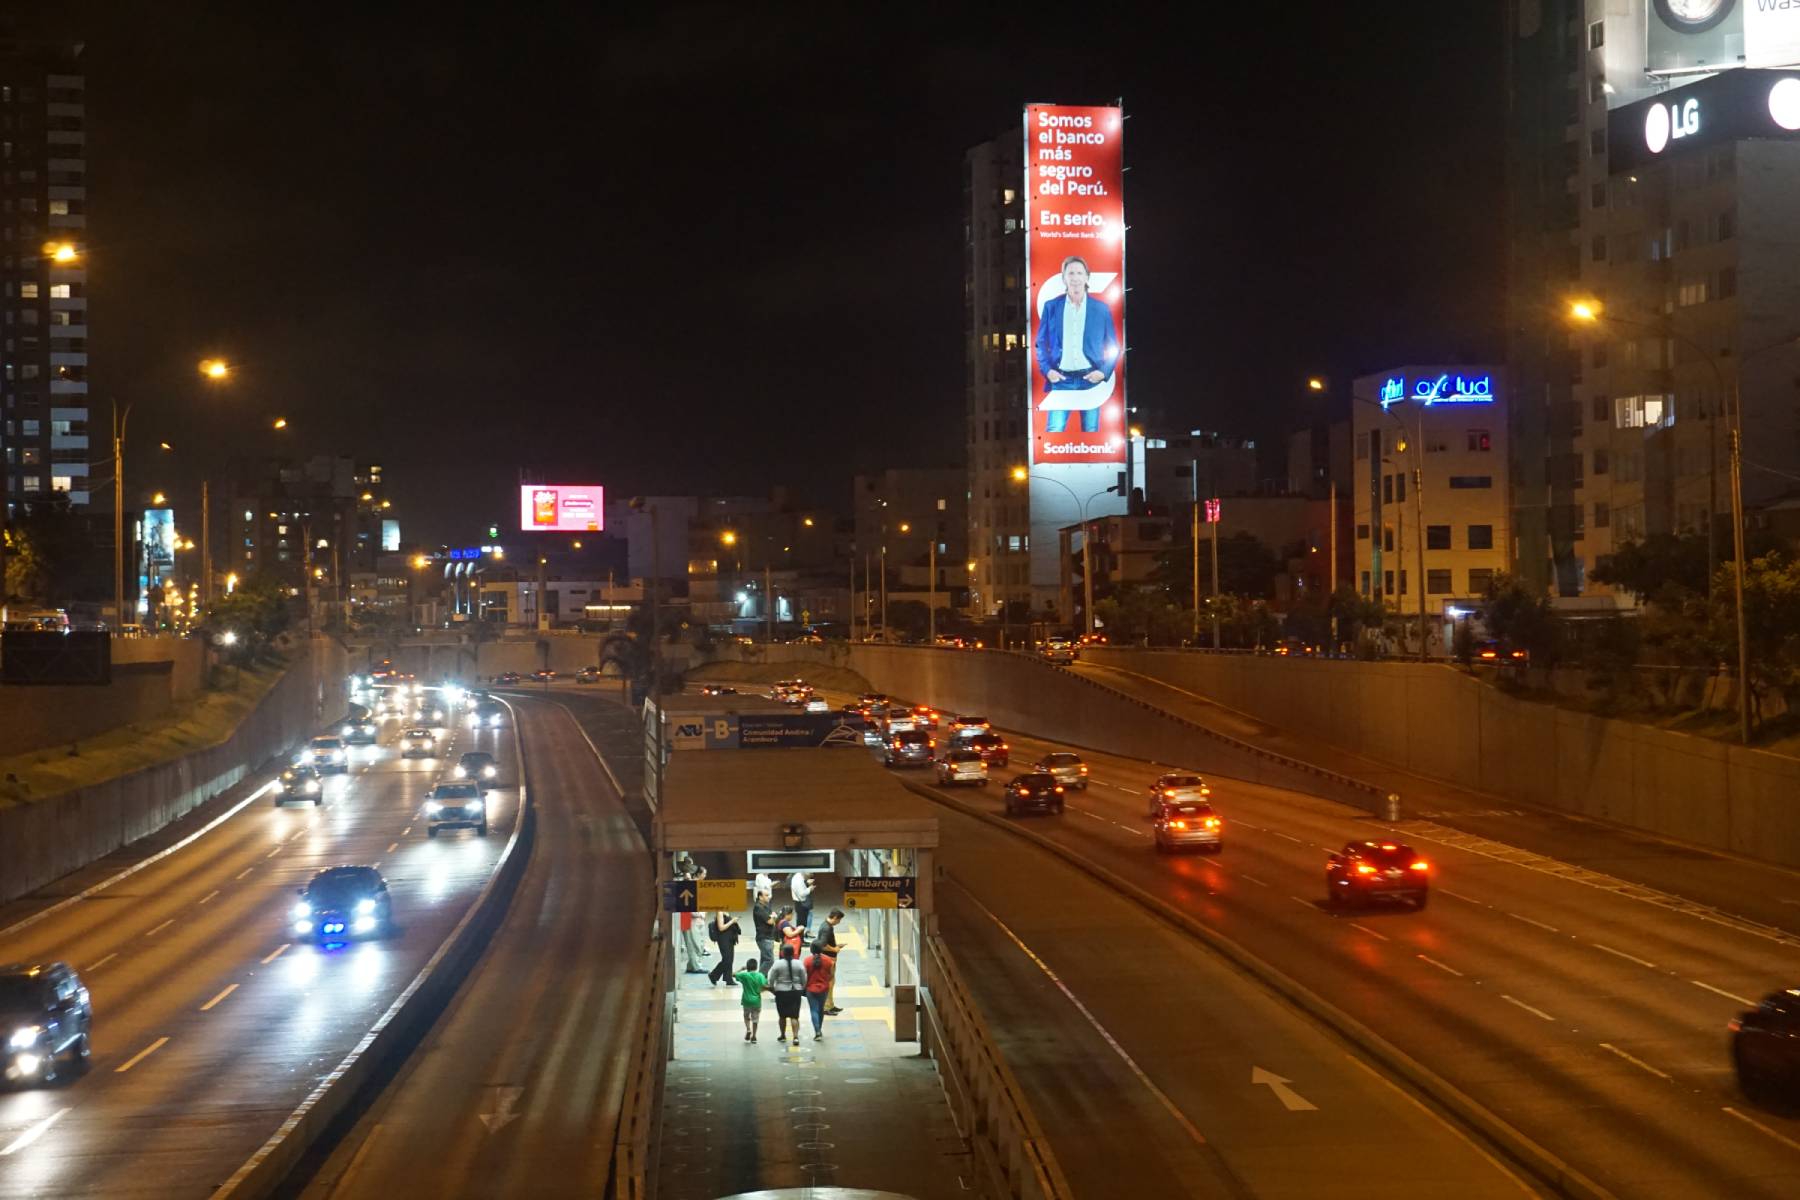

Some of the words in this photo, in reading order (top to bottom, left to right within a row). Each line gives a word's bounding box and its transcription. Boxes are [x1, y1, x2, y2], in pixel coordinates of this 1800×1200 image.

[1039, 112, 1092, 127] Somos
[1671, 98, 1699, 139] LG
[1039, 129, 1053, 143] el
[1056, 129, 1105, 144] banco
[1039, 146, 1072, 160] más
[1039, 165, 1093, 180] seguro
[1039, 180, 1064, 195] del
[1067, 181, 1108, 195] Perú.
[1040, 210, 1061, 225] En
[675, 723, 703, 737] ATU
[714, 720, 729, 739] B
[848, 878, 901, 889] Embarque
[904, 879, 910, 888] 1
